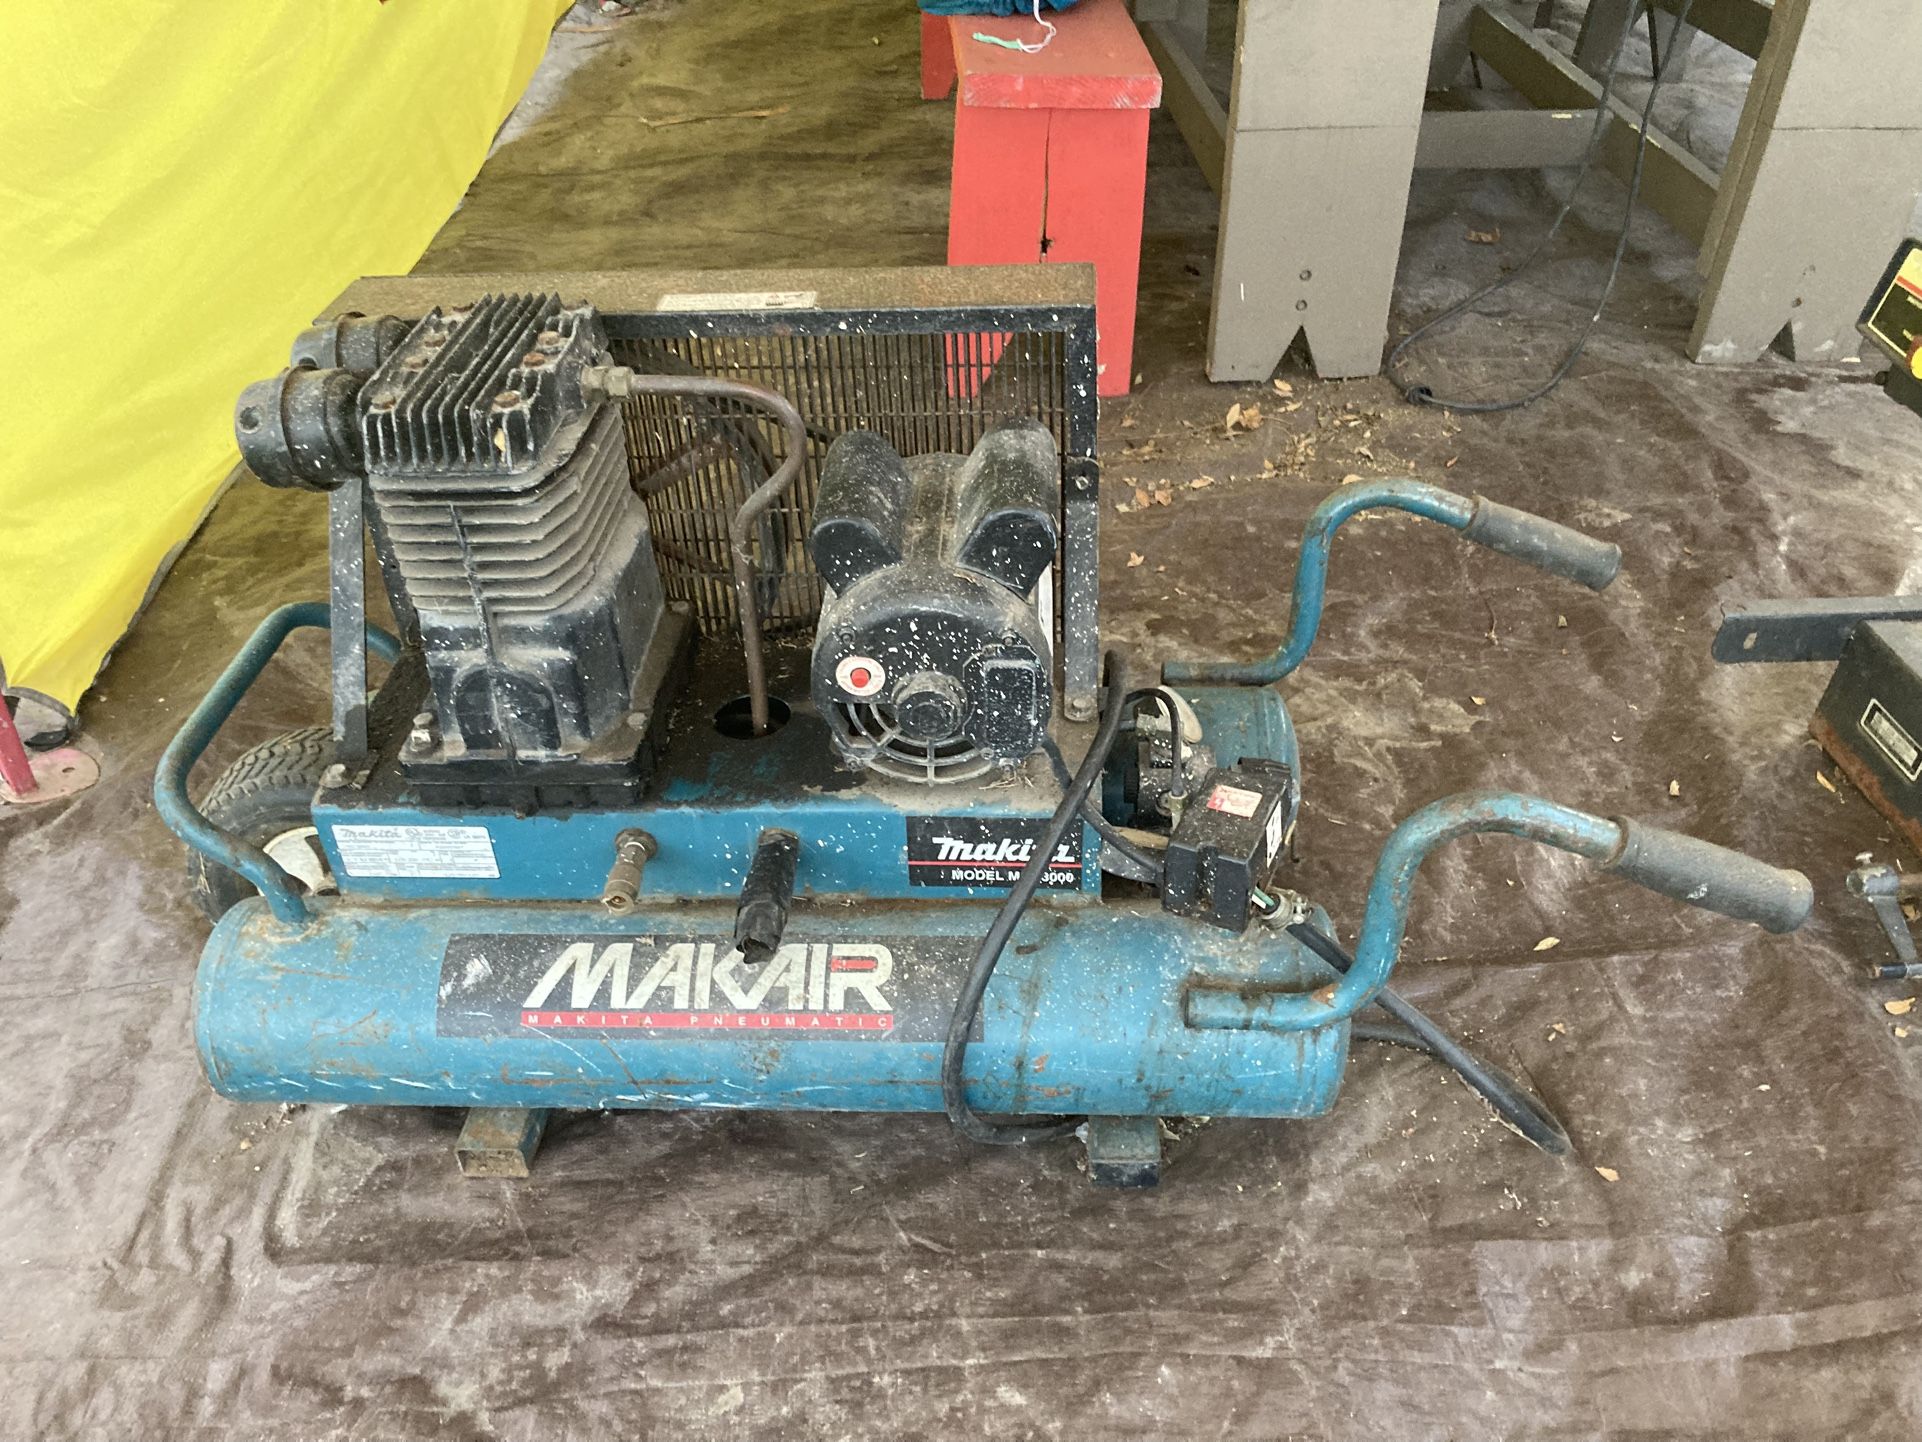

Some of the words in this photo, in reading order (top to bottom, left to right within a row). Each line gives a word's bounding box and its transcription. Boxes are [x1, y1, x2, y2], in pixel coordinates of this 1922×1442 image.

[951, 869, 1005, 881] MODEL
[1007, 870, 1074, 883] M3000
[522, 943, 892, 1010] MAKAIR
[528, 1014, 654, 1027] MAKITA
[690, 1016, 889, 1028] PNEUMATIC
